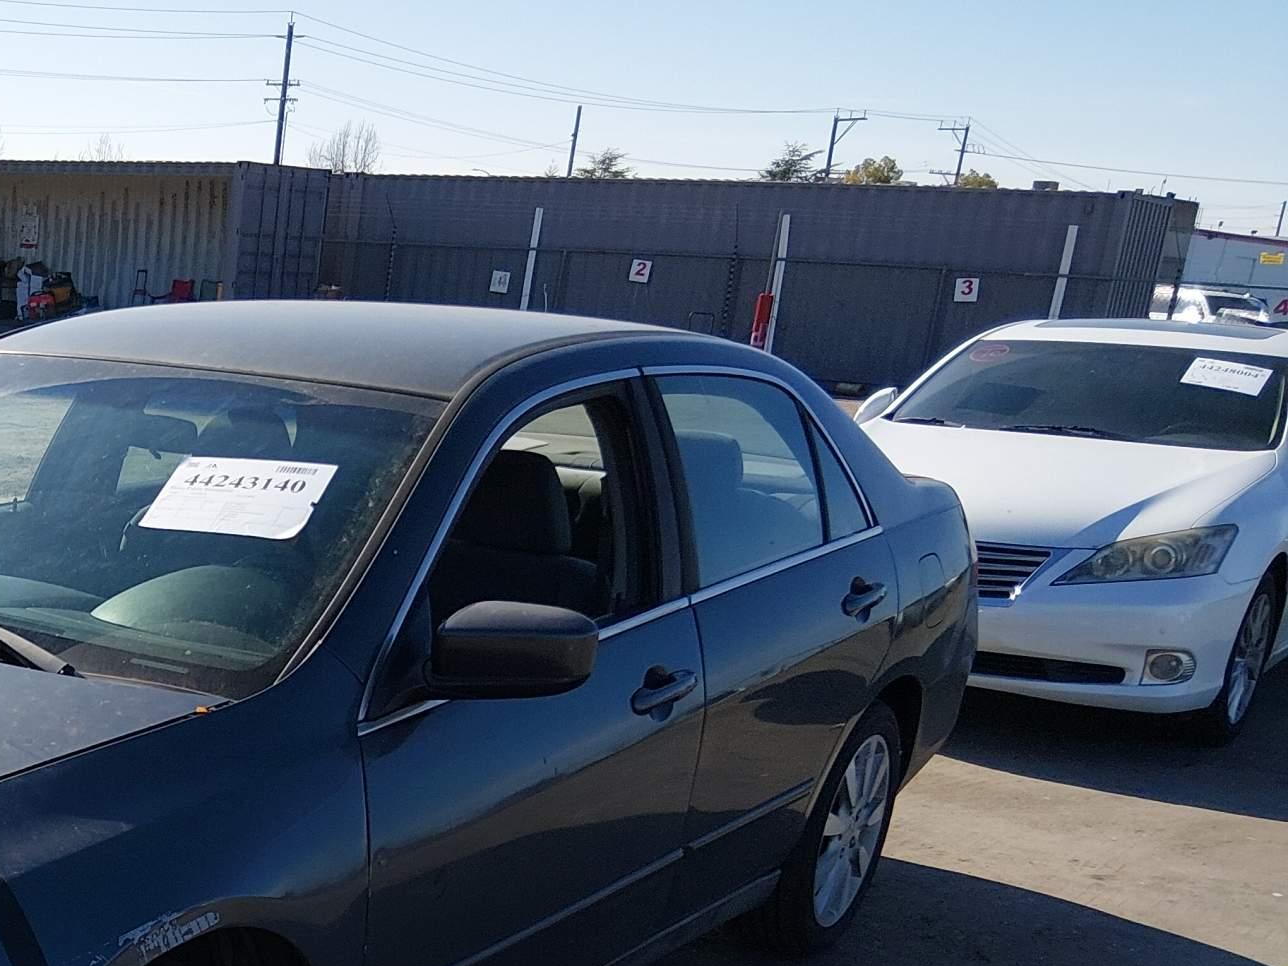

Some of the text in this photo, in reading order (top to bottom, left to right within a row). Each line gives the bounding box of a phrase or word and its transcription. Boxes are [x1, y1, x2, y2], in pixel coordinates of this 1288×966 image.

[634, 261, 647, 276] 2
[960, 279, 974, 296] 3
[183, 473, 307, 494] 44243140
